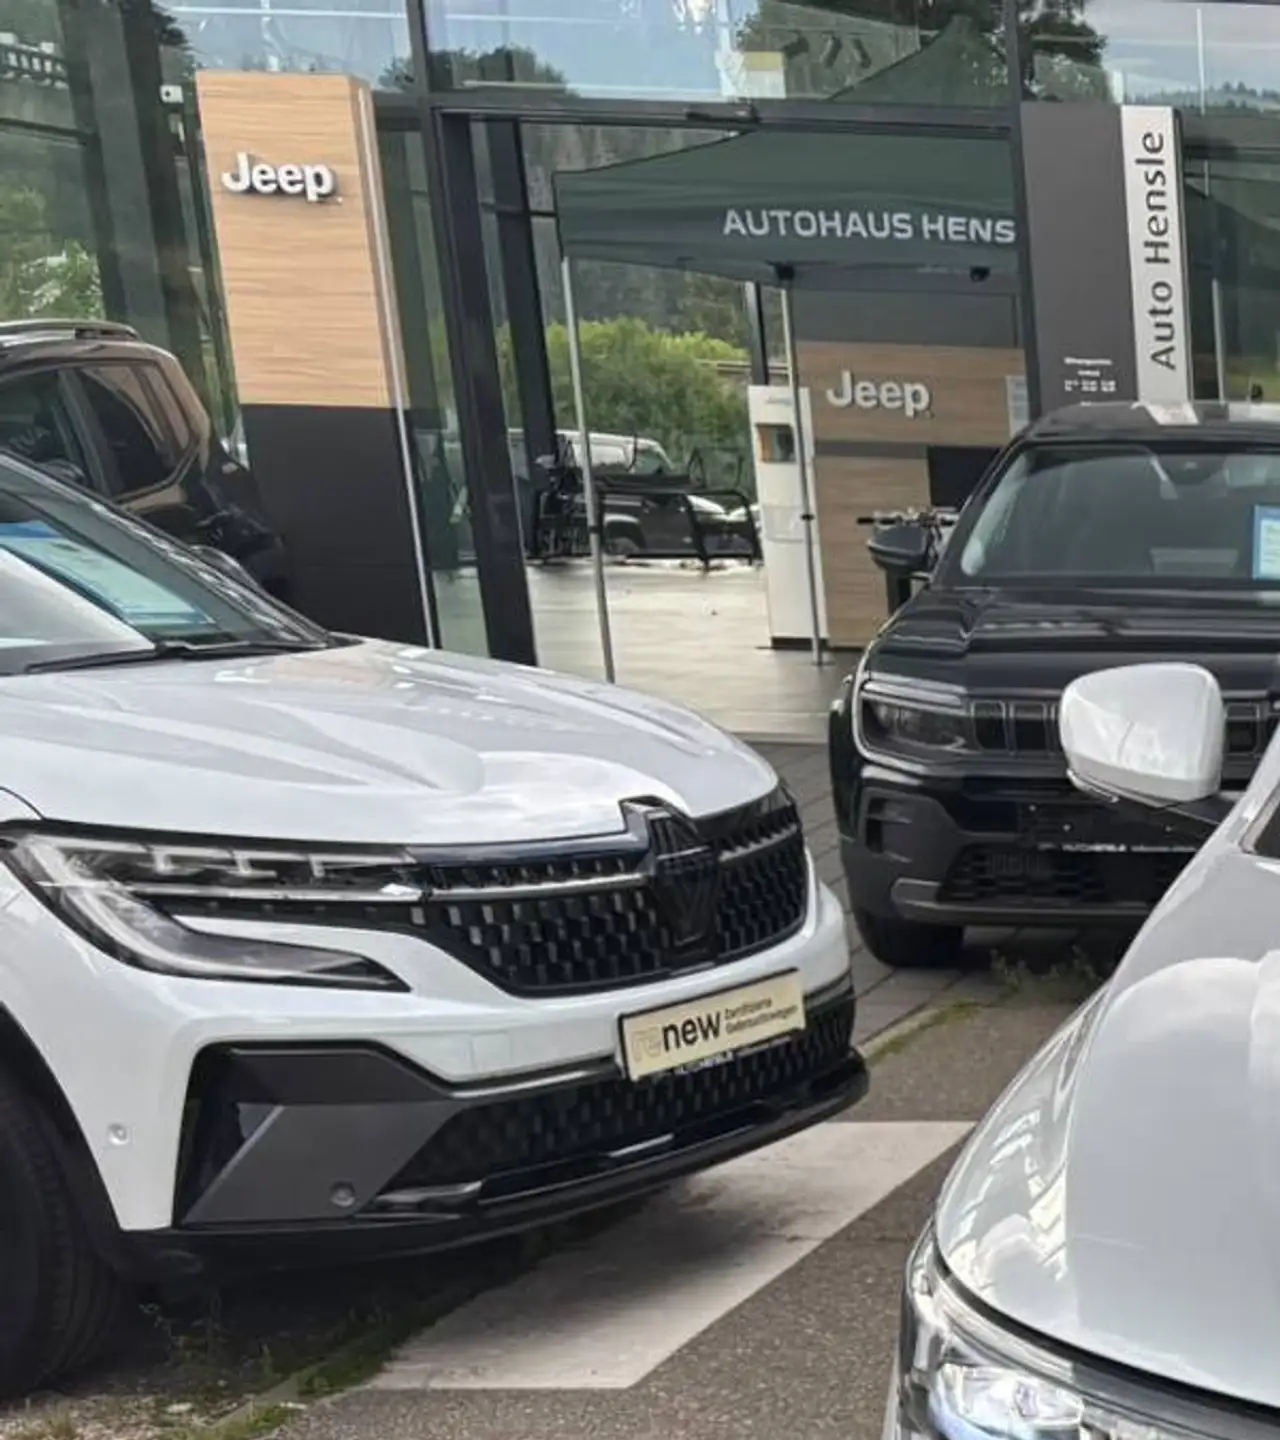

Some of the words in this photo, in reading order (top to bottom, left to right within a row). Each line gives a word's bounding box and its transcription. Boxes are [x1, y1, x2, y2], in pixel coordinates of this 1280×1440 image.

[221, 151, 333, 202] Jeep
[1135, 130, 1171, 264] Hensle
[723, 209, 913, 240] AUTOHAUS
[1149, 281, 1177, 371] Auto
[825, 369, 930, 417] Jeep
